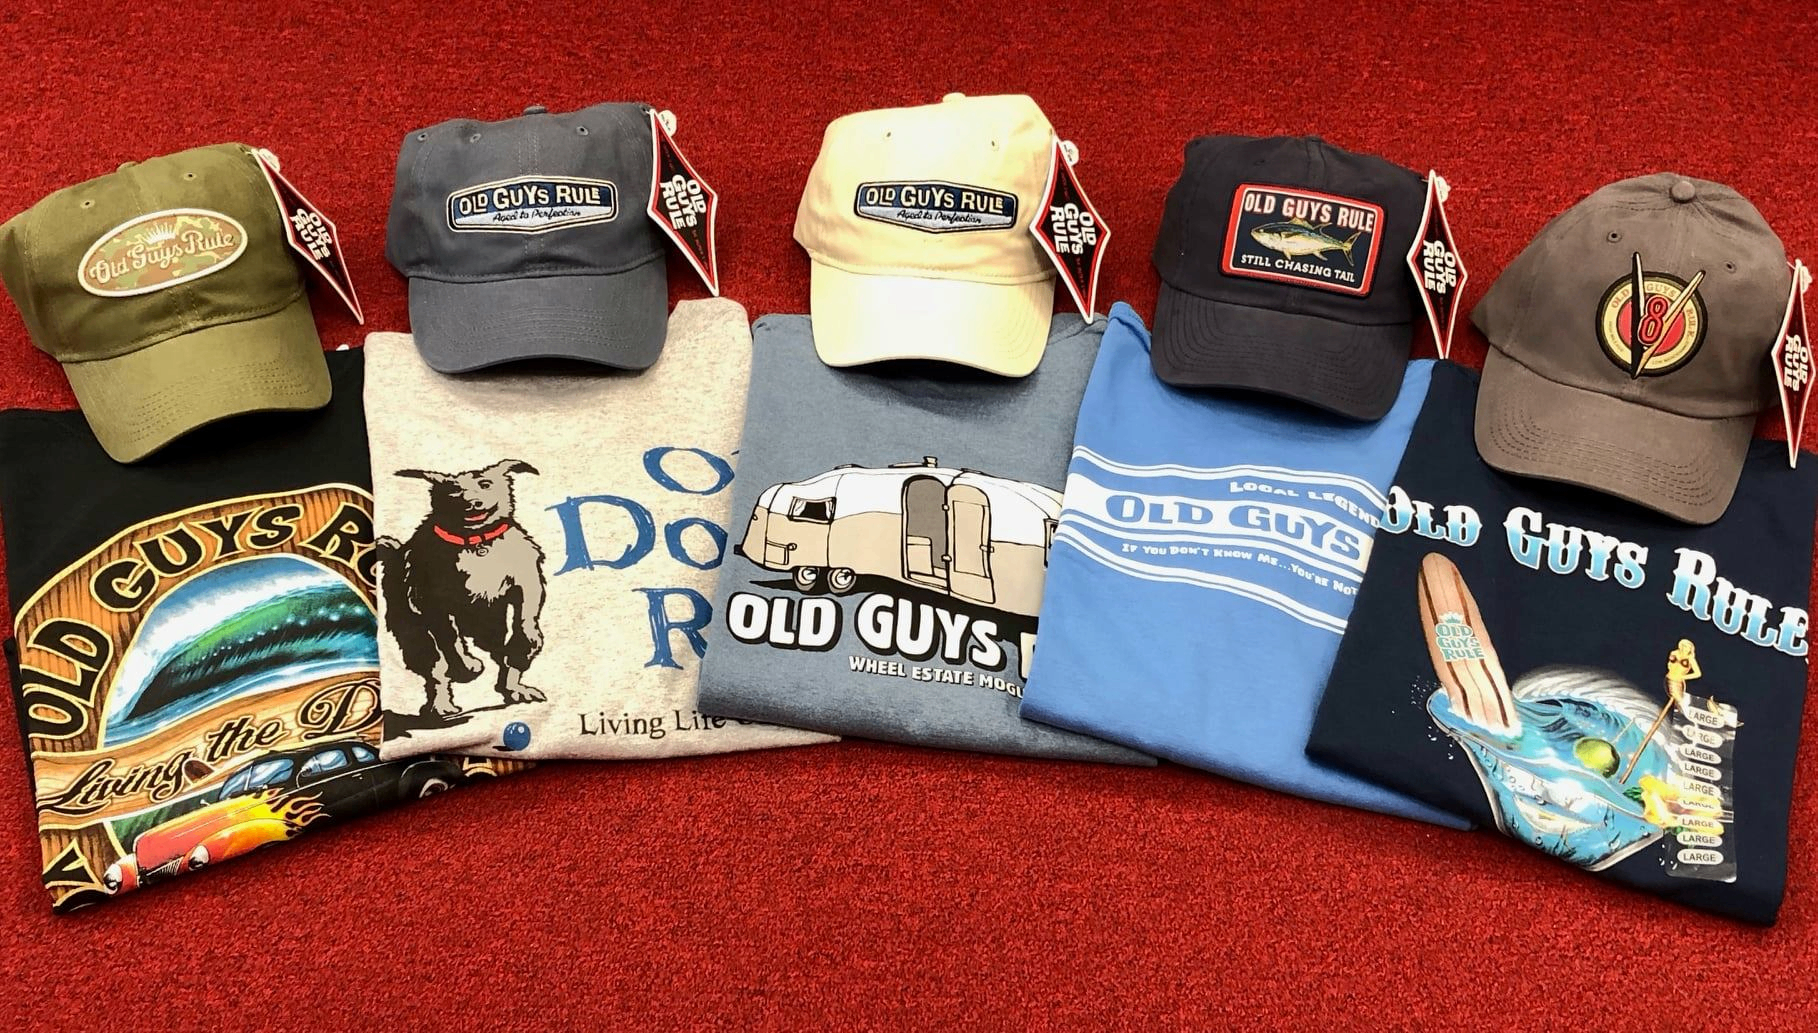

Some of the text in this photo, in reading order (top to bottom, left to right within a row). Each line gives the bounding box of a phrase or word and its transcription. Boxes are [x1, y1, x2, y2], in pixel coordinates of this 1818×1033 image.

[458, 185, 601, 215] OLD GUYS RULE
[660, 181, 686, 230] RULE
[672, 174, 698, 228] GUYS
[686, 179, 707, 214] OLD
[865, 185, 1004, 214] OLD GUYS RULE
[1244, 193, 1375, 233] OLD GUYS RULE
[297, 208, 331, 258] GUYS
[308, 212, 333, 246] OLD
[493, 208, 581, 223] Aged to Perfection
[896, 209, 982, 224] Aged to Perfection
[1050, 205, 1070, 254] RULE
[1064, 202, 1084, 255] GUYS
[1079, 211, 1097, 247] OLD
[290, 215, 324, 261] RULE
[89, 230, 235, 284] Old Guys Rule
[1240, 254, 1356, 283] STILL CHASING TAIL
[1423, 239, 1436, 291] RULE
[1433, 240, 1447, 295] GUYS
[1444, 251, 1457, 288] OLD
[1611, 289, 1631, 309] OLD
[1646, 282, 1678, 298] GUYS
[1638, 294, 1669, 346] 8
[1783, 333, 1794, 388] RULE
[1799, 345, 1809, 385] OLD
[1229, 481, 1300, 497] LOCAL
[1105, 494, 1361, 561] OLD GUYS
[1121, 543, 1138, 553] IF
[1142, 545, 1167, 556] YOU
[1169, 546, 1209, 558] DON'T
[1213, 549, 1253, 561] KNOW
[1377, 485, 1810, 657] OLD GUYS RULE
[20, 616, 114, 740] OLD
[89, 502, 305, 613] GUYS
[727, 592, 842, 650] OLD
[854, 592, 1006, 671] GUYS
[1435, 623, 1474, 638] OLD
[1435, 636, 1480, 651] GUYS
[1440, 648, 1486, 662] RULE
[848, 655, 906, 678] WHEEL
[911, 665, 974, 686] ESTATE
[578, 711, 666, 740] Living
[35, 757, 195, 816] Living
[205, 715, 291, 763] the
[1684, 746, 1715, 762] LARGE
[1684, 764, 1715, 778] LARGE
[1683, 781, 1714, 797] LARGE
[1682, 818, 1714, 829] LARGE
[1682, 834, 1716, 845] LARGE
[1683, 851, 1717, 863] LARGE
